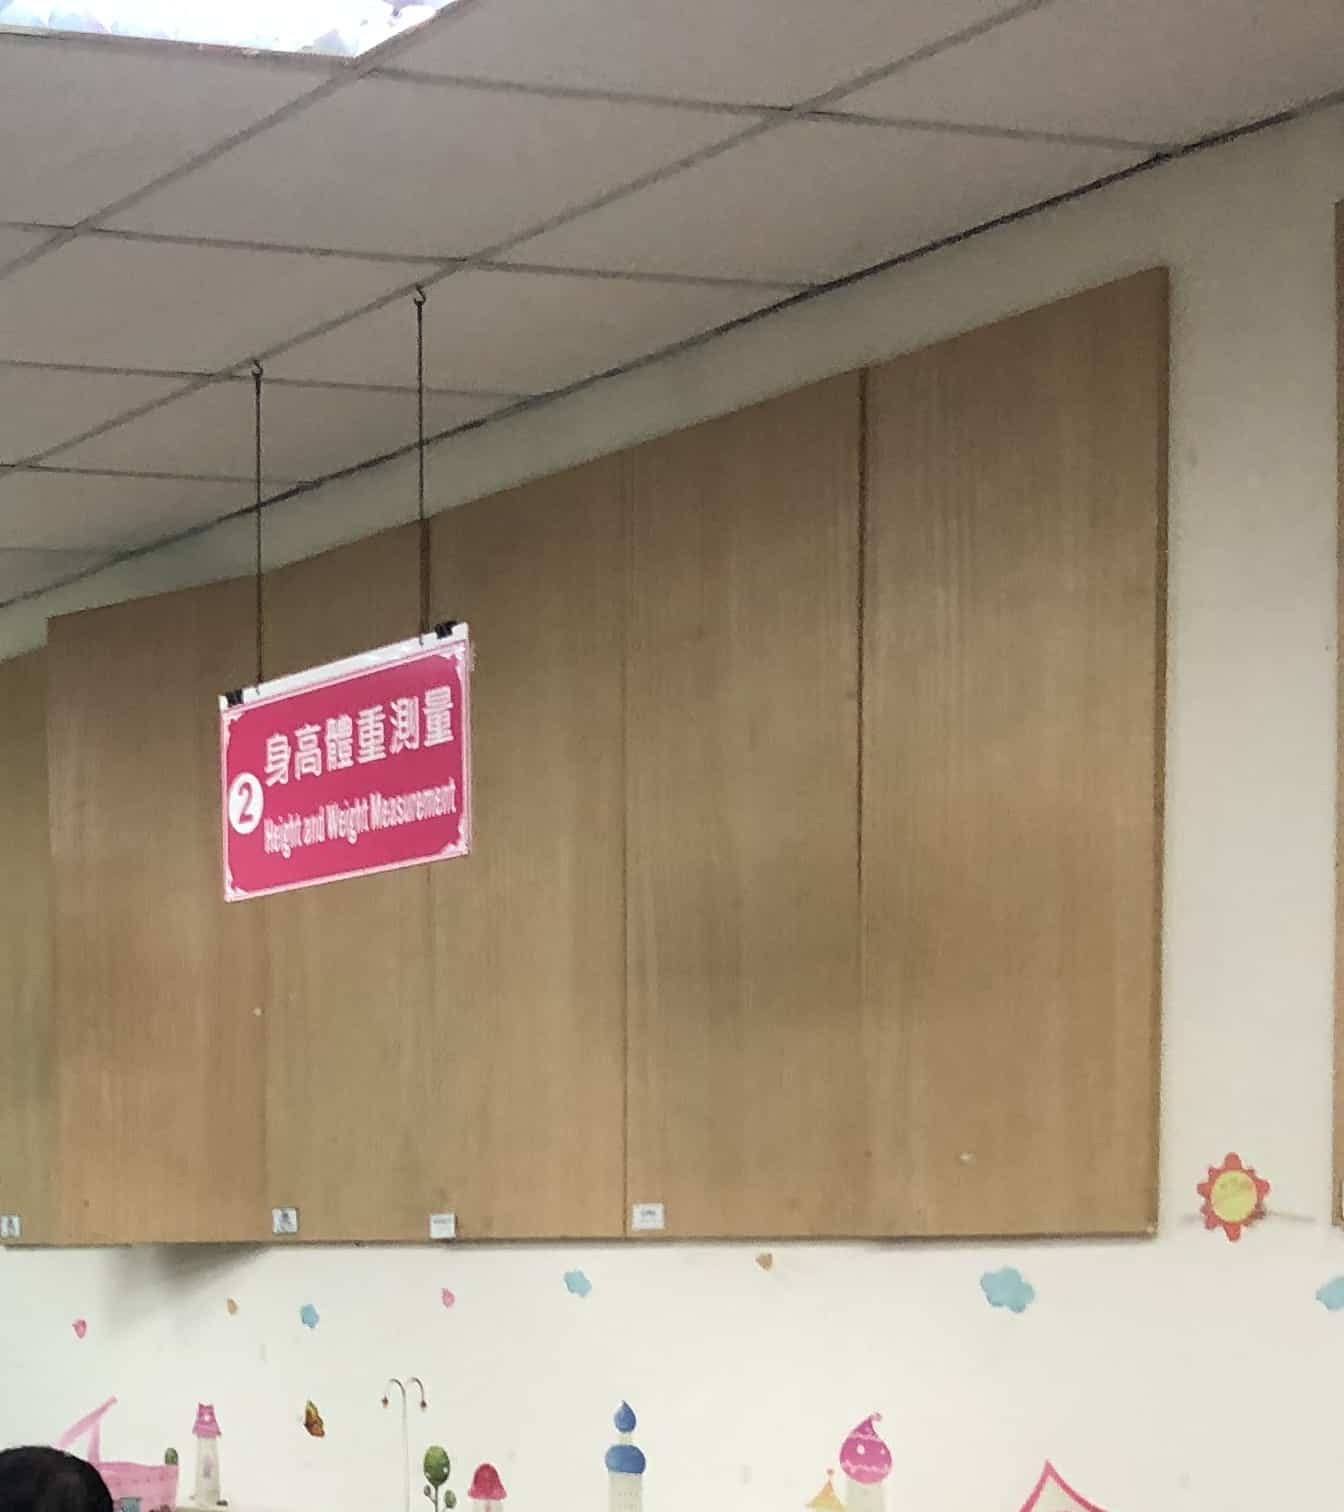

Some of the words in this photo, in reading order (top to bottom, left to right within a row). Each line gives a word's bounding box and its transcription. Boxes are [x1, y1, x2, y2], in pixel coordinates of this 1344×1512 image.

[263, 686, 454, 787] 身高體重測量
[238, 780, 254, 825] 2
[263, 811, 302, 859] Height
[303, 805, 325, 847] and
[326, 795, 369, 845] Weight
[370, 777, 457, 831] Measurement
